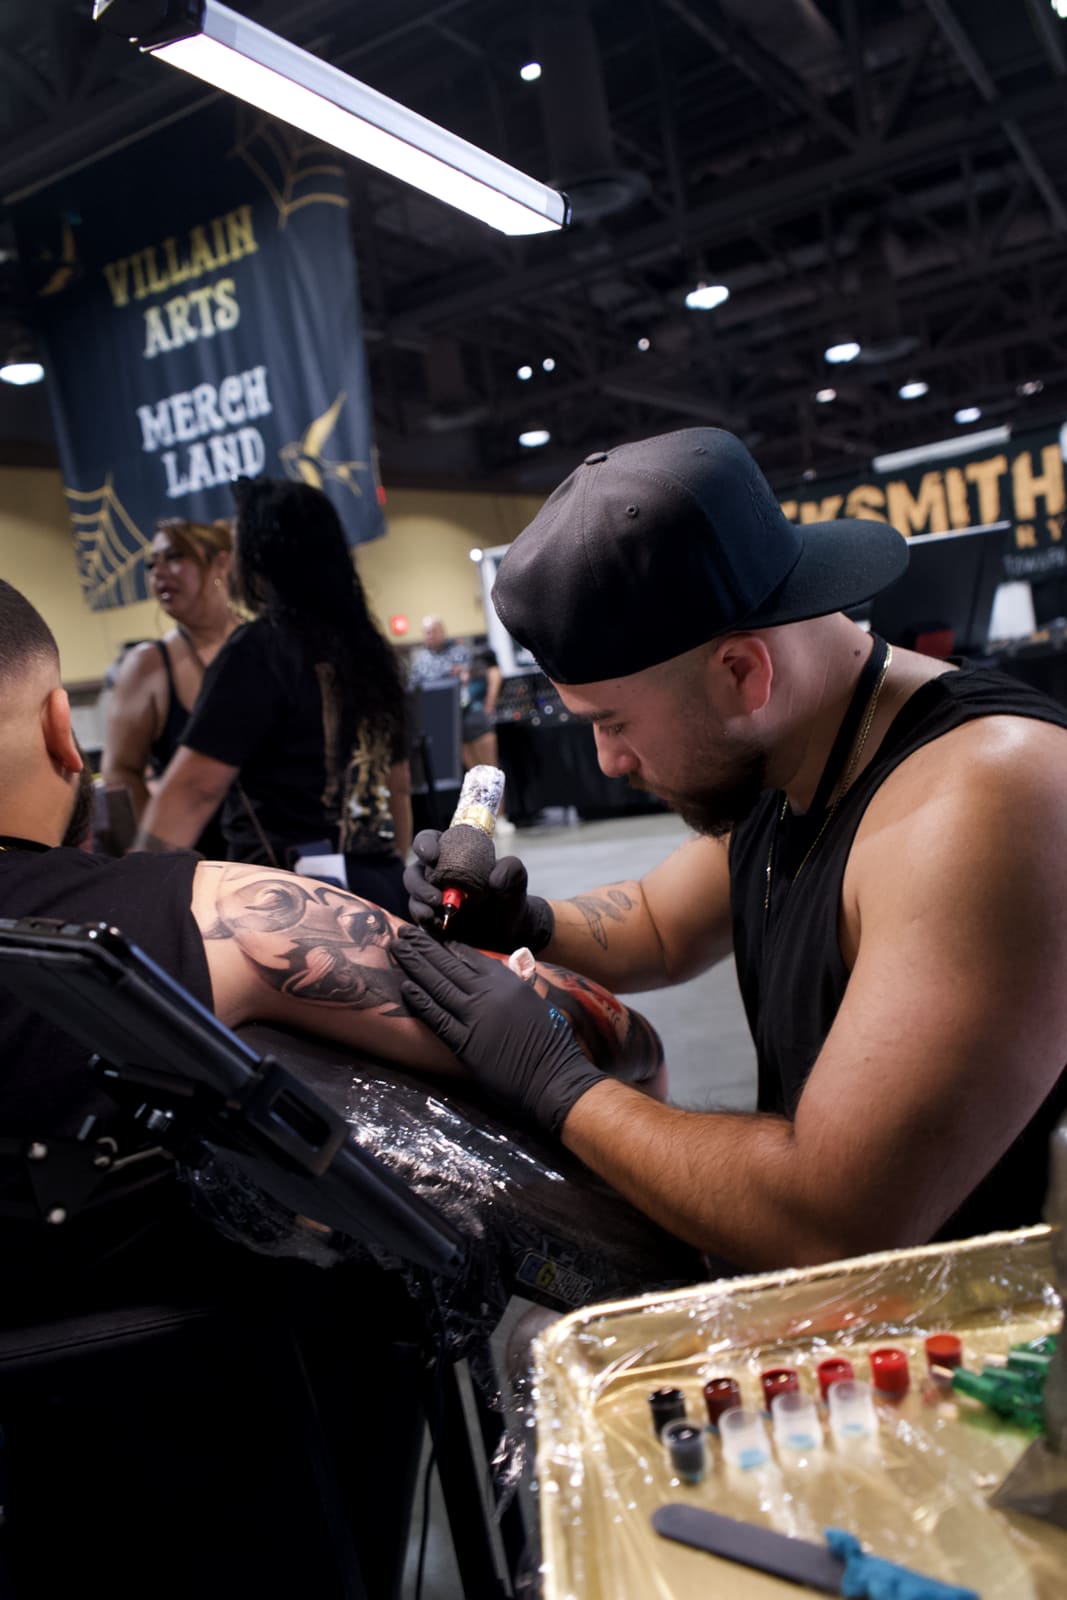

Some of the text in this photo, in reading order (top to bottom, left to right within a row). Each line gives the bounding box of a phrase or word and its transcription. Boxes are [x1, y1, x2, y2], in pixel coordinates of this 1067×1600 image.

[103, 204, 258, 307] VILLAIN
[143, 277, 240, 359] ARTS
[136, 365, 272, 452] MERCH
[161, 426, 266, 498] LAND
[780, 444, 1065, 538] KSMITH
